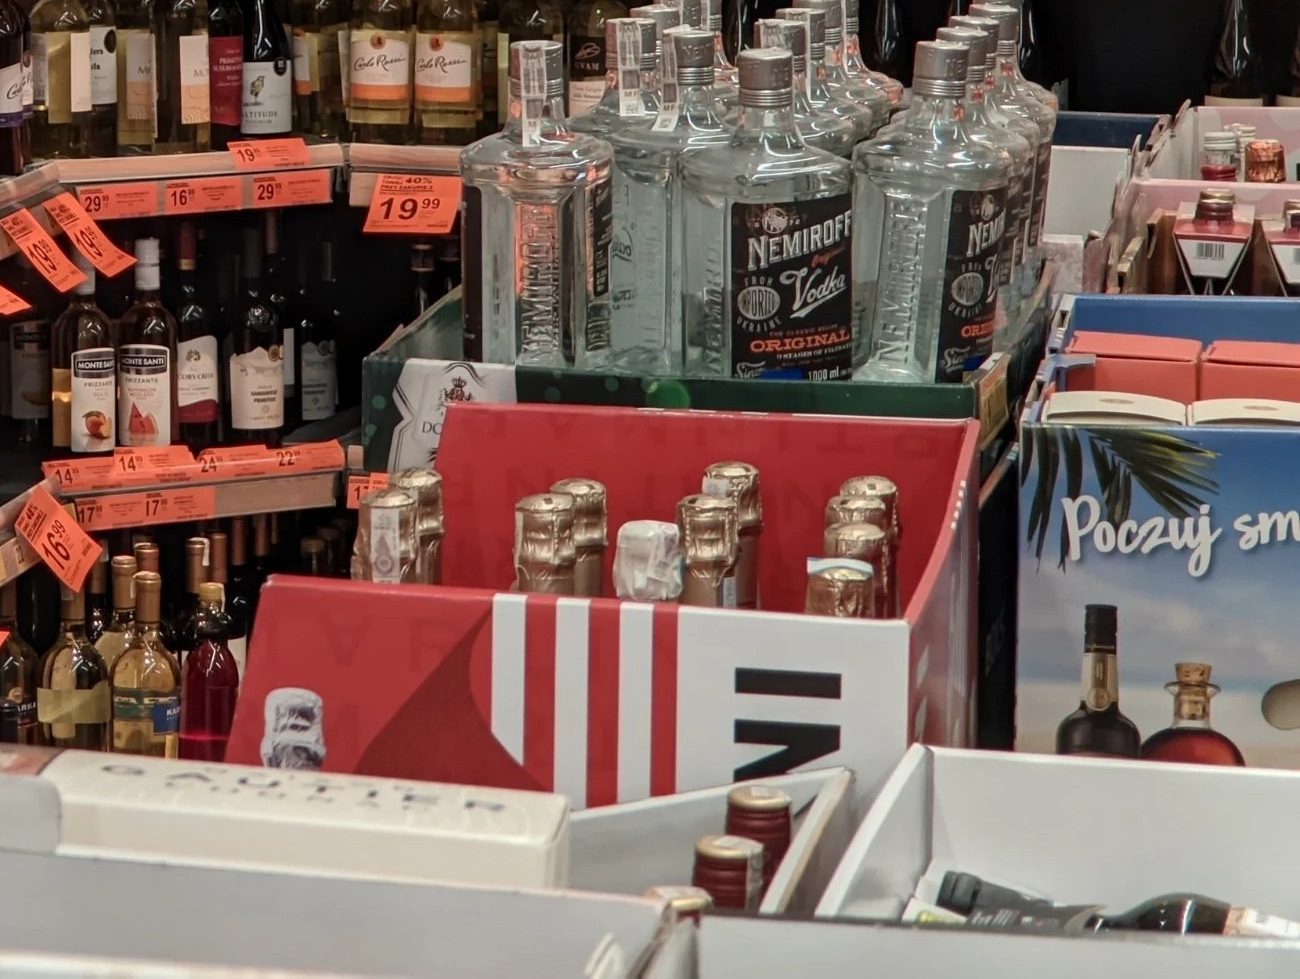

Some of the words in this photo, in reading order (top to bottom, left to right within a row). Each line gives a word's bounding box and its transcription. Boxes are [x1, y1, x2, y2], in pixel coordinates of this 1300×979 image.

[747, 208, 852, 272] NEMIROFF
[779, 264, 848, 319] Vodka
[749, 328, 850, 354] ORIGINAL
[1061, 495, 1222, 578] Poczuj
